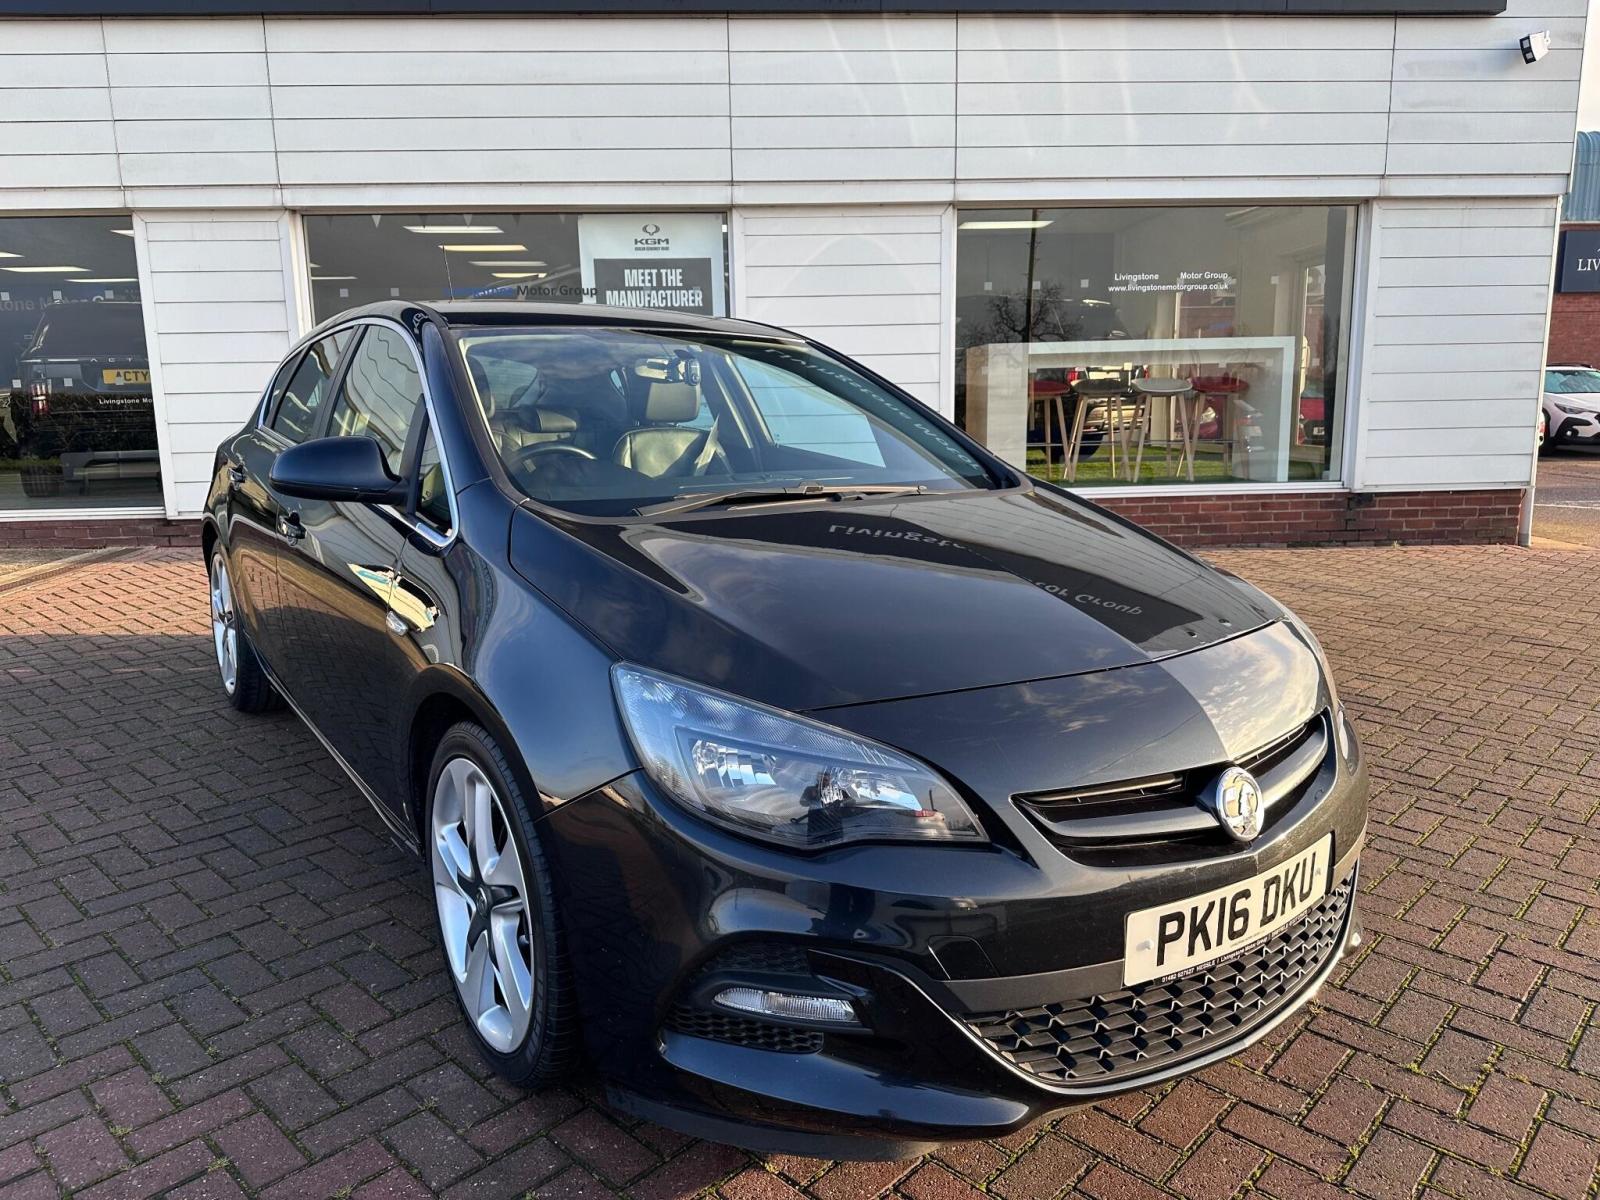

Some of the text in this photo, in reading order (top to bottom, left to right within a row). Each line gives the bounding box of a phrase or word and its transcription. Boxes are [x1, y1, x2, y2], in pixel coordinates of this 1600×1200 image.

[624, 269, 683, 287] MEET THE
[1114, 271, 1228, 282] Livingstone Motor Group
[516, 285, 555, 296] Motor
[559, 285, 598, 300] Group
[1108, 282, 1229, 293] www.livingstonemotorgroup.co.uk
[606, 290, 703, 307] MANUFACTURER
[98, 398, 140, 406] Livingstone
[1156, 851, 1316, 967] PK16 DKU
